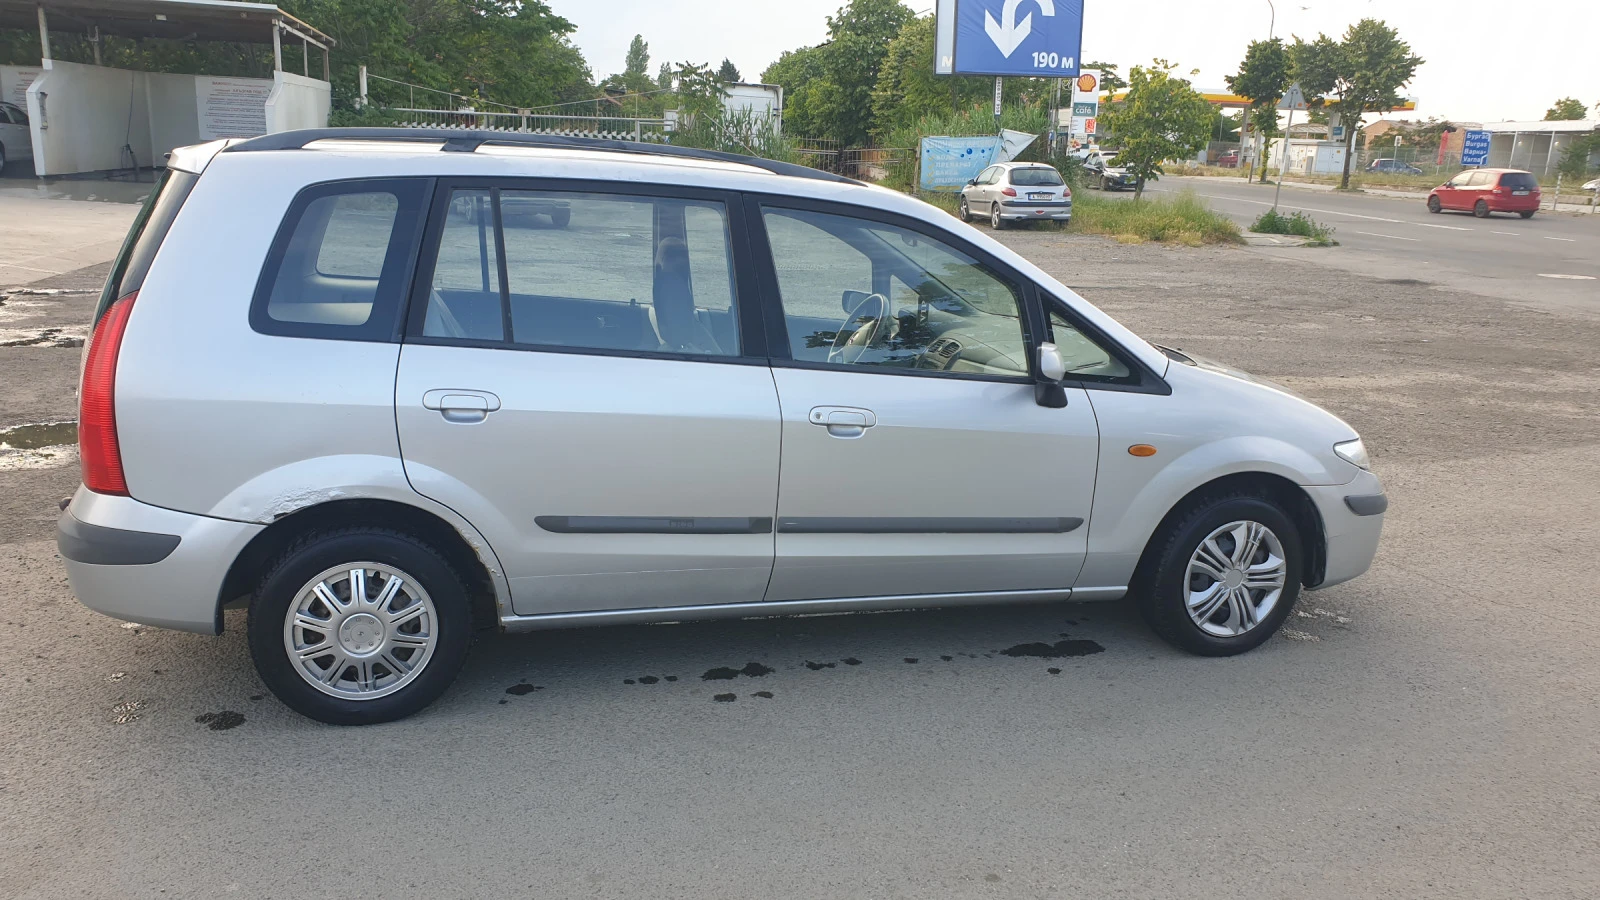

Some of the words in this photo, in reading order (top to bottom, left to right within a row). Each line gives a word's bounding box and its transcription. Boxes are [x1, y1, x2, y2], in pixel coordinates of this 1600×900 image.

[1032, 52, 1058, 68] 190
[1075, 106, 1092, 114] café
[1465, 140, 1488, 148] Burgas
